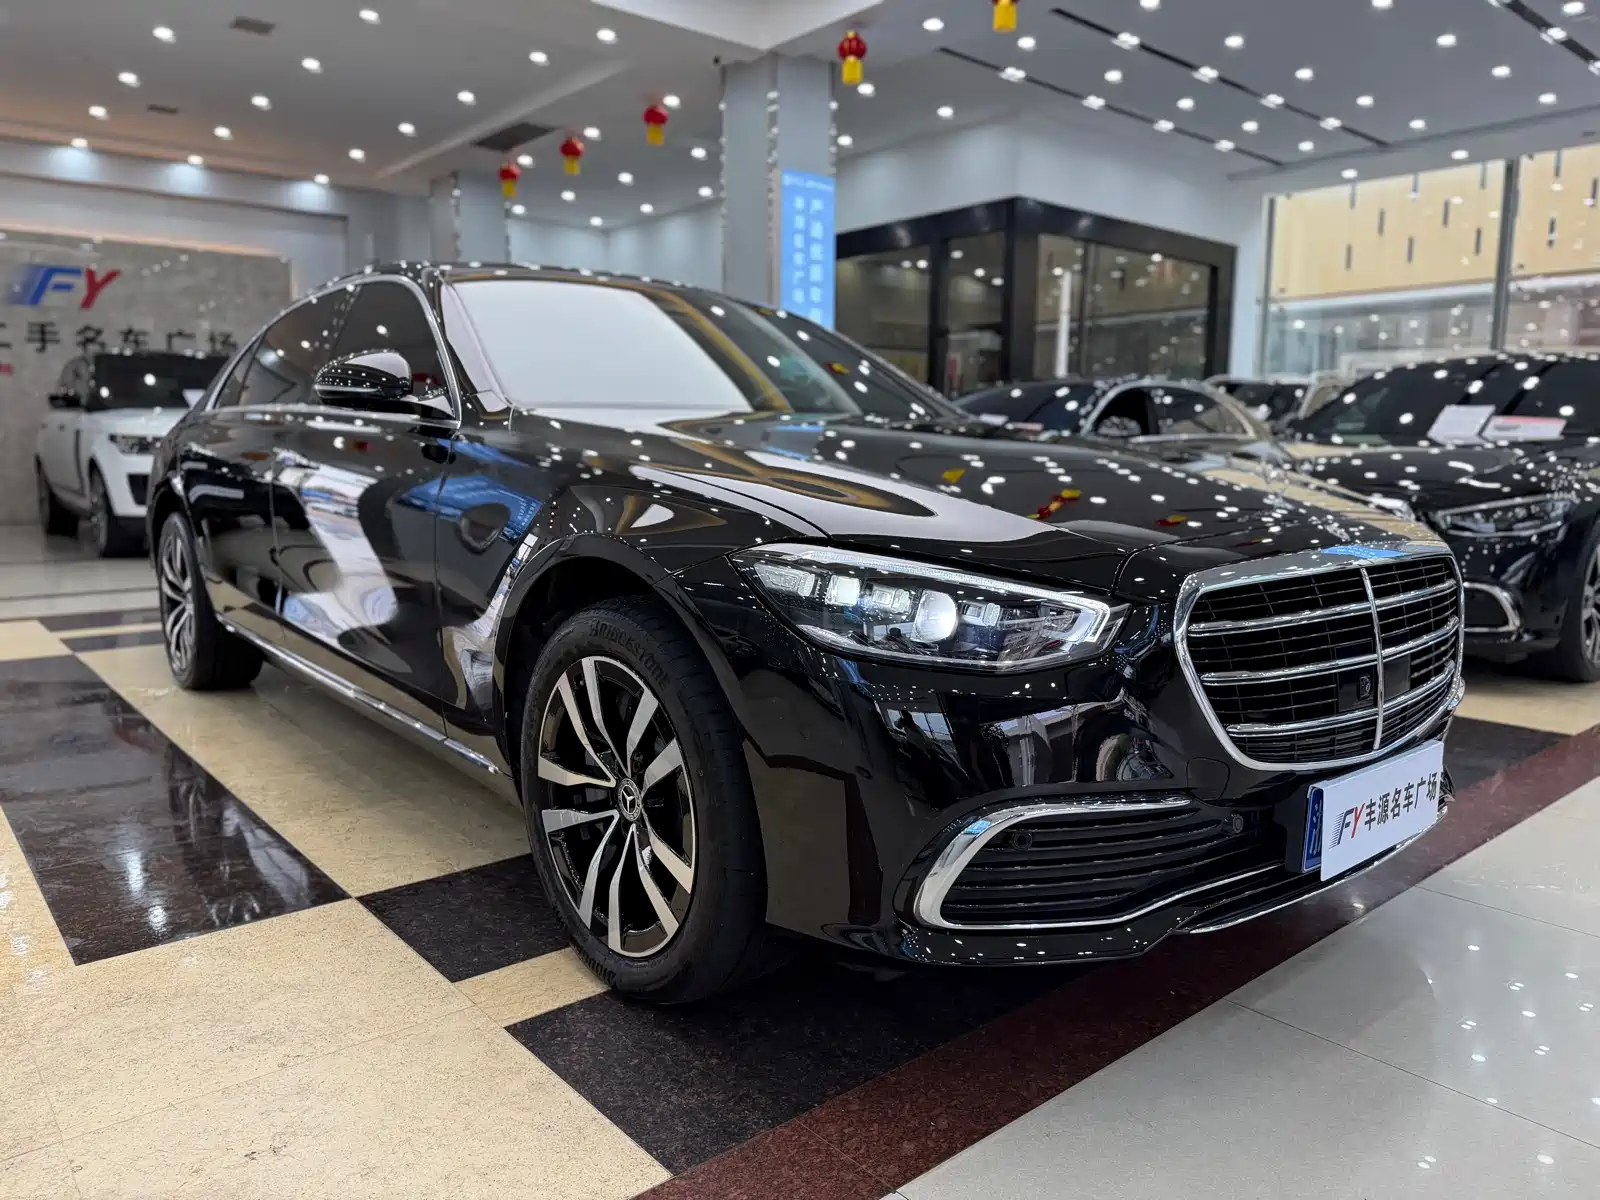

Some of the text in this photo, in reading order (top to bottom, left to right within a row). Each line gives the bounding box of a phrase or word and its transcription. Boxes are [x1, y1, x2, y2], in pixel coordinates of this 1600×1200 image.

[1364, 772, 1438, 831] 丰源名车广场
